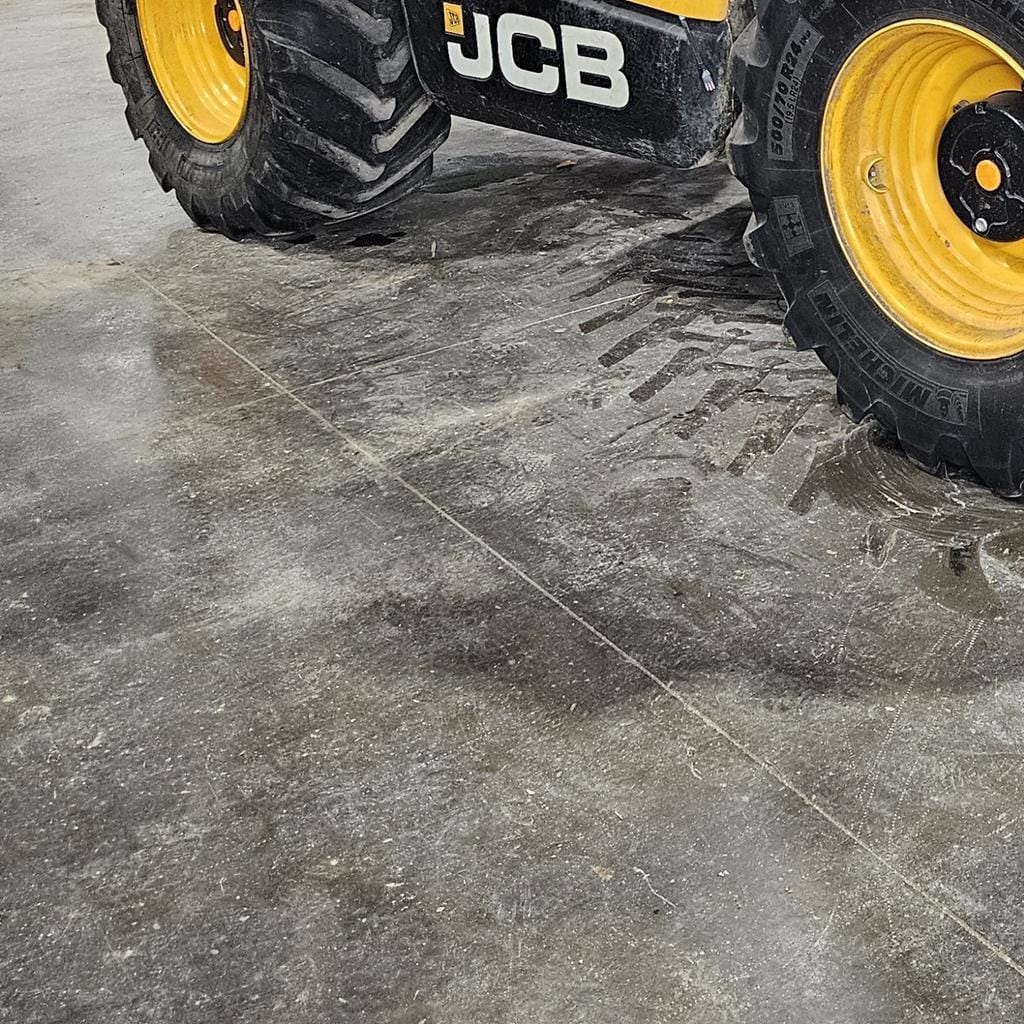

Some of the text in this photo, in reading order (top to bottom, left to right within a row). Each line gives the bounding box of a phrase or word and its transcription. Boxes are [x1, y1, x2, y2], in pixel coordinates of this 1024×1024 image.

[447, 12, 630, 108] JCB
[770, 80, 789, 156] 500/70
[780, 40, 803, 82] R24
[813, 292, 934, 408] MICHELIN
